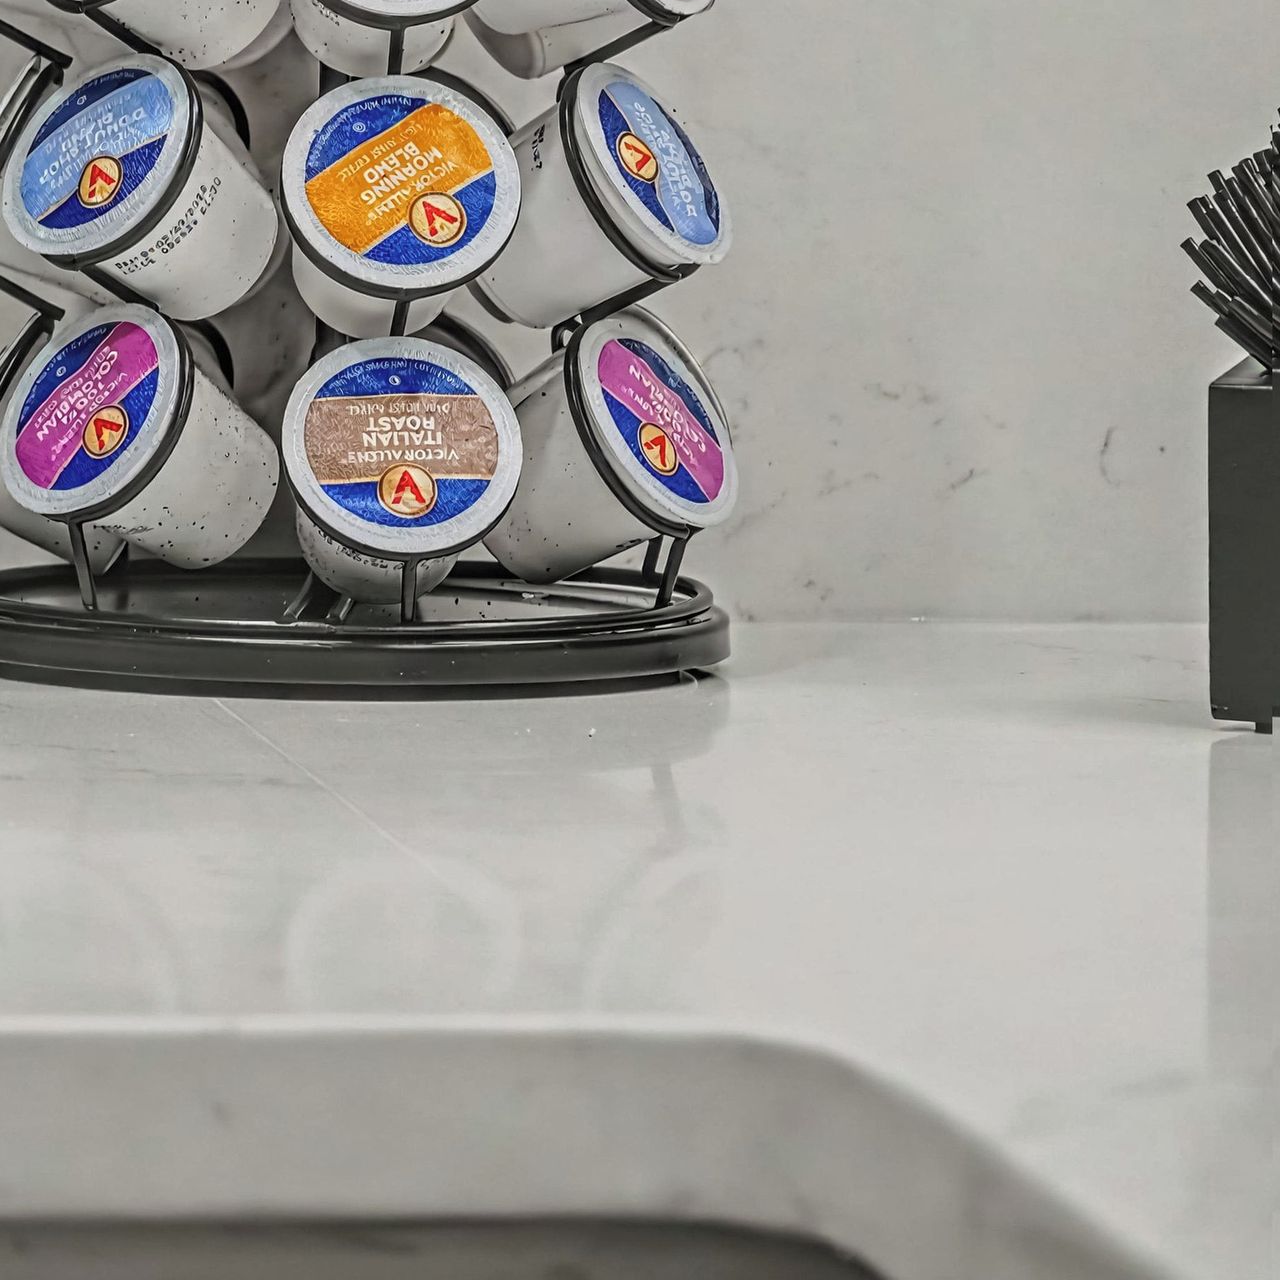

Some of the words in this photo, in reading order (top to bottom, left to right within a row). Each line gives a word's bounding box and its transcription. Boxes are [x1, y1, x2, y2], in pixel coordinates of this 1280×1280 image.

[362, 141, 421, 184] BLEND
[367, 416, 435, 432] ROAST
[362, 431, 442, 447] ITALIAN
